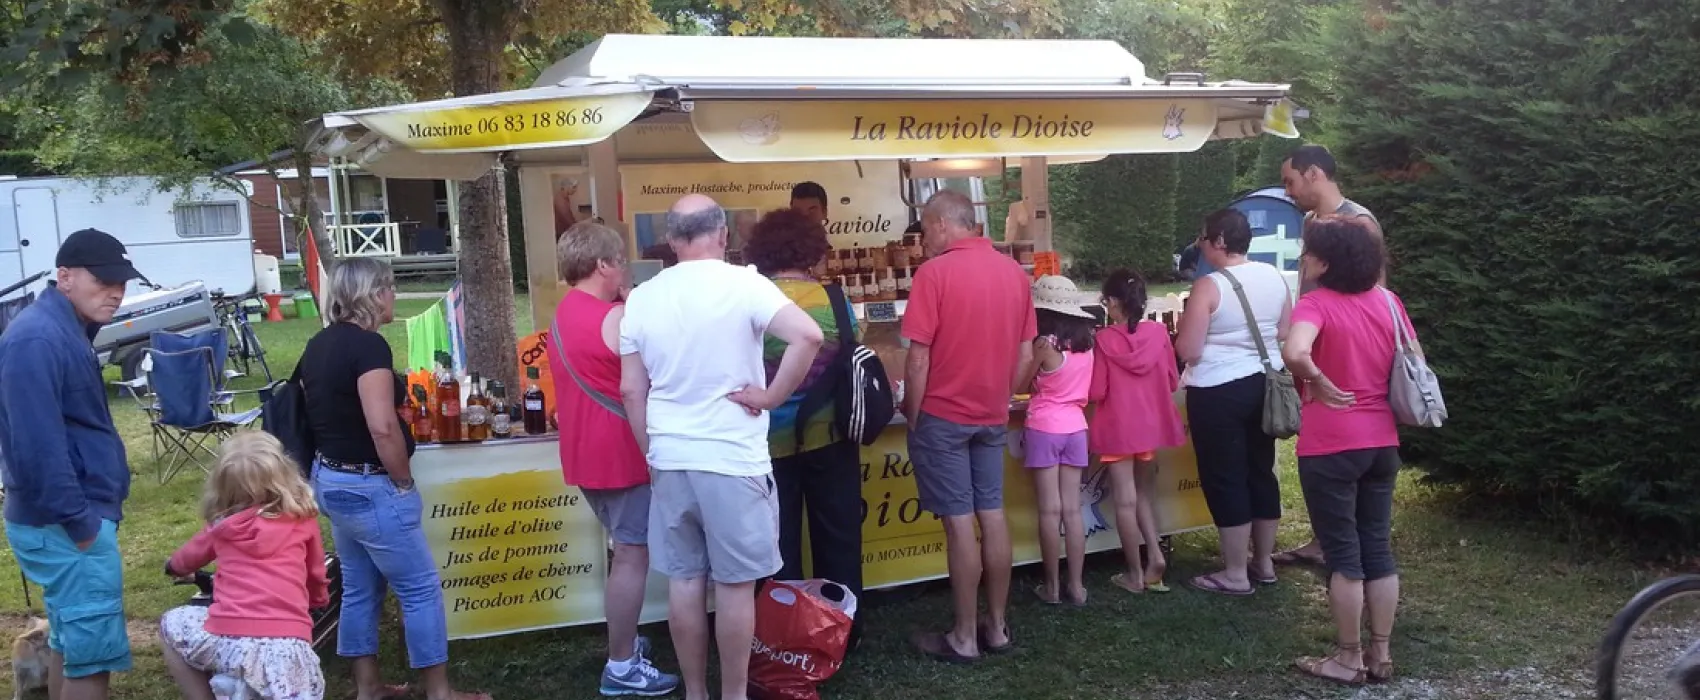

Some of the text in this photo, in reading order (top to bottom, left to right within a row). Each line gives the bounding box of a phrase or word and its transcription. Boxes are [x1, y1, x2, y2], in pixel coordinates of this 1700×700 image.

[407, 107, 603, 139] Maxime 06 83 18 86 86
[850, 113, 1094, 141] La Raviole Dioise
[640, 184, 689, 196] Maxime
[430, 494, 579, 519] Huile de noisette
[450, 518, 564, 541] Huile d'olive
[442, 542, 569, 570] Jus de pomme
[877, 541, 944, 562] MONTLAUR
[440, 561, 593, 590] omages de chèvre
[452, 584, 568, 613] Picodon AOC
